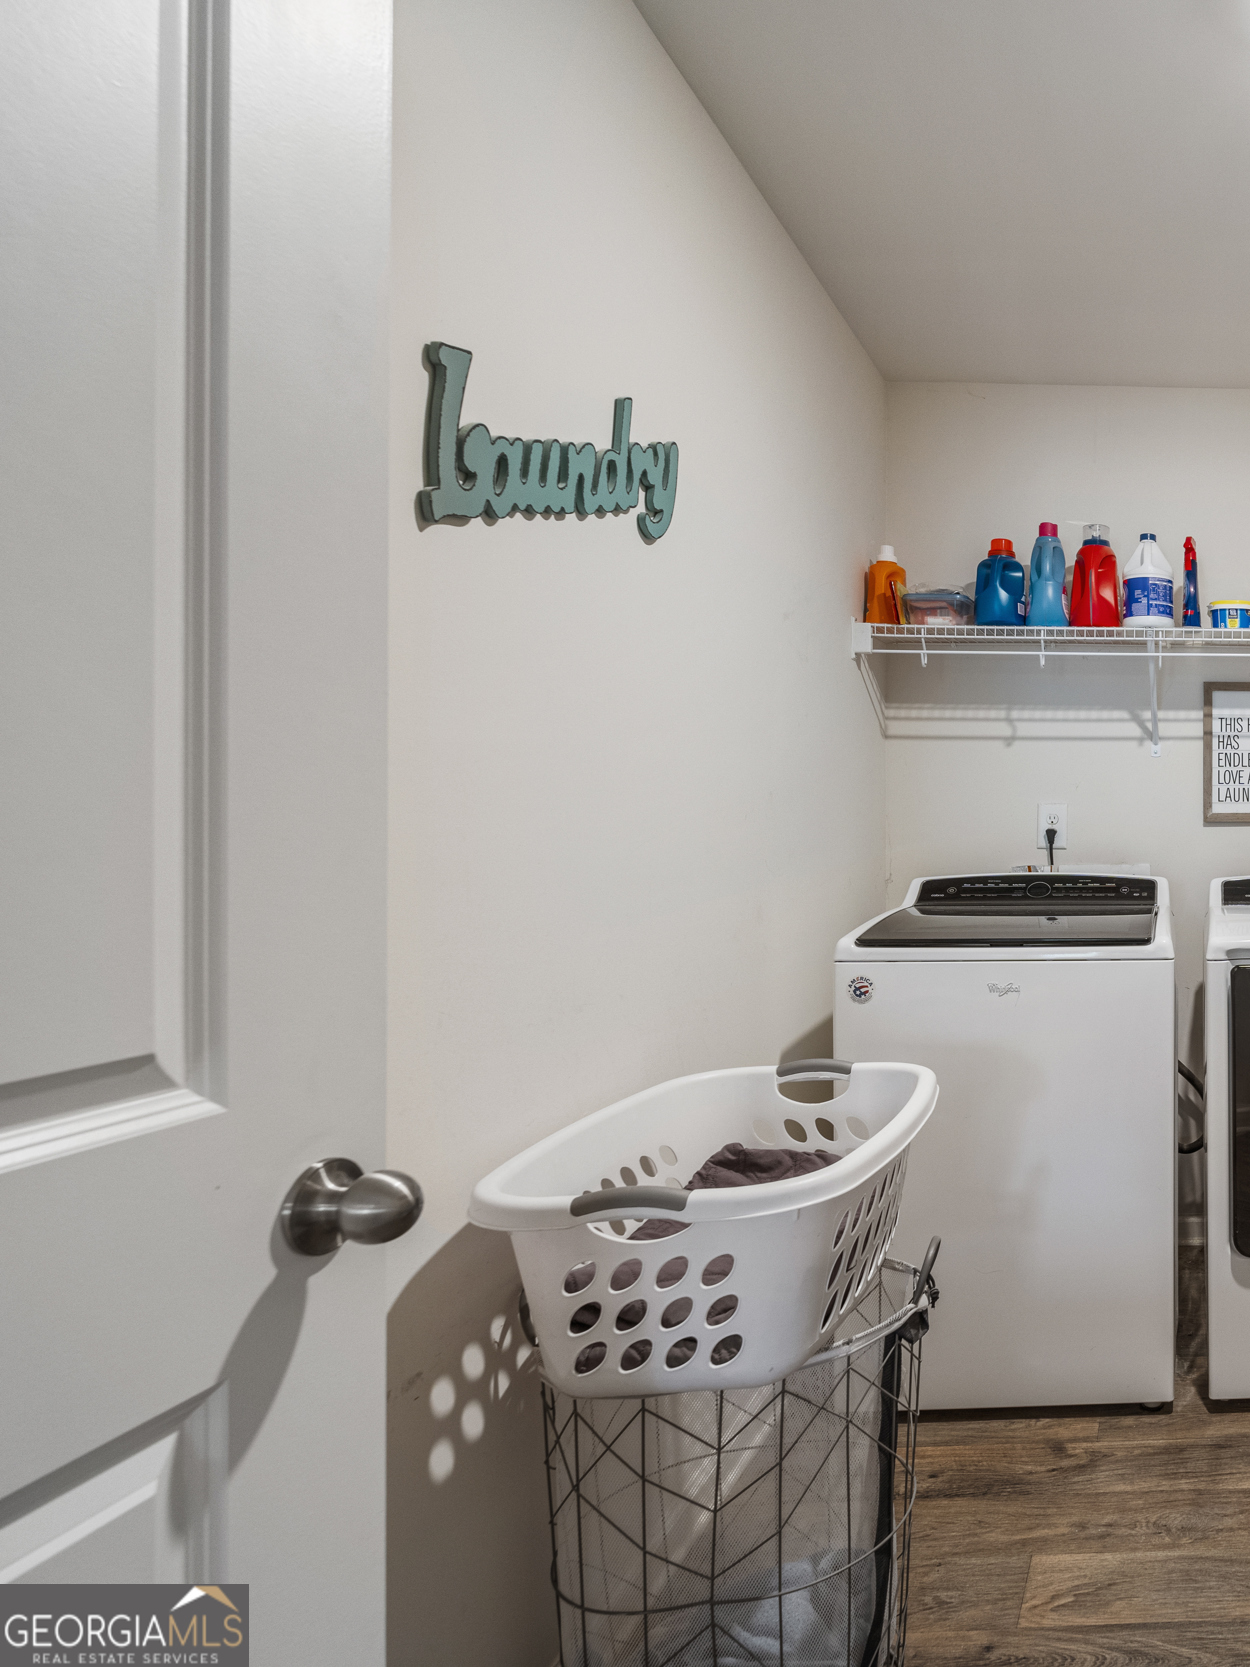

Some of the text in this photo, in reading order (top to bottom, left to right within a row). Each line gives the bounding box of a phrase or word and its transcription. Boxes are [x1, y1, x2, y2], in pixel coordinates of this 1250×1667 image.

[418, 341, 679, 540] Laundry
[1218, 717, 1243, 733] THIS
[1217, 734, 1240, 750] HAS
[1217, 769, 1245, 785] LOVE
[847, 976, 874, 989] AMERICA
